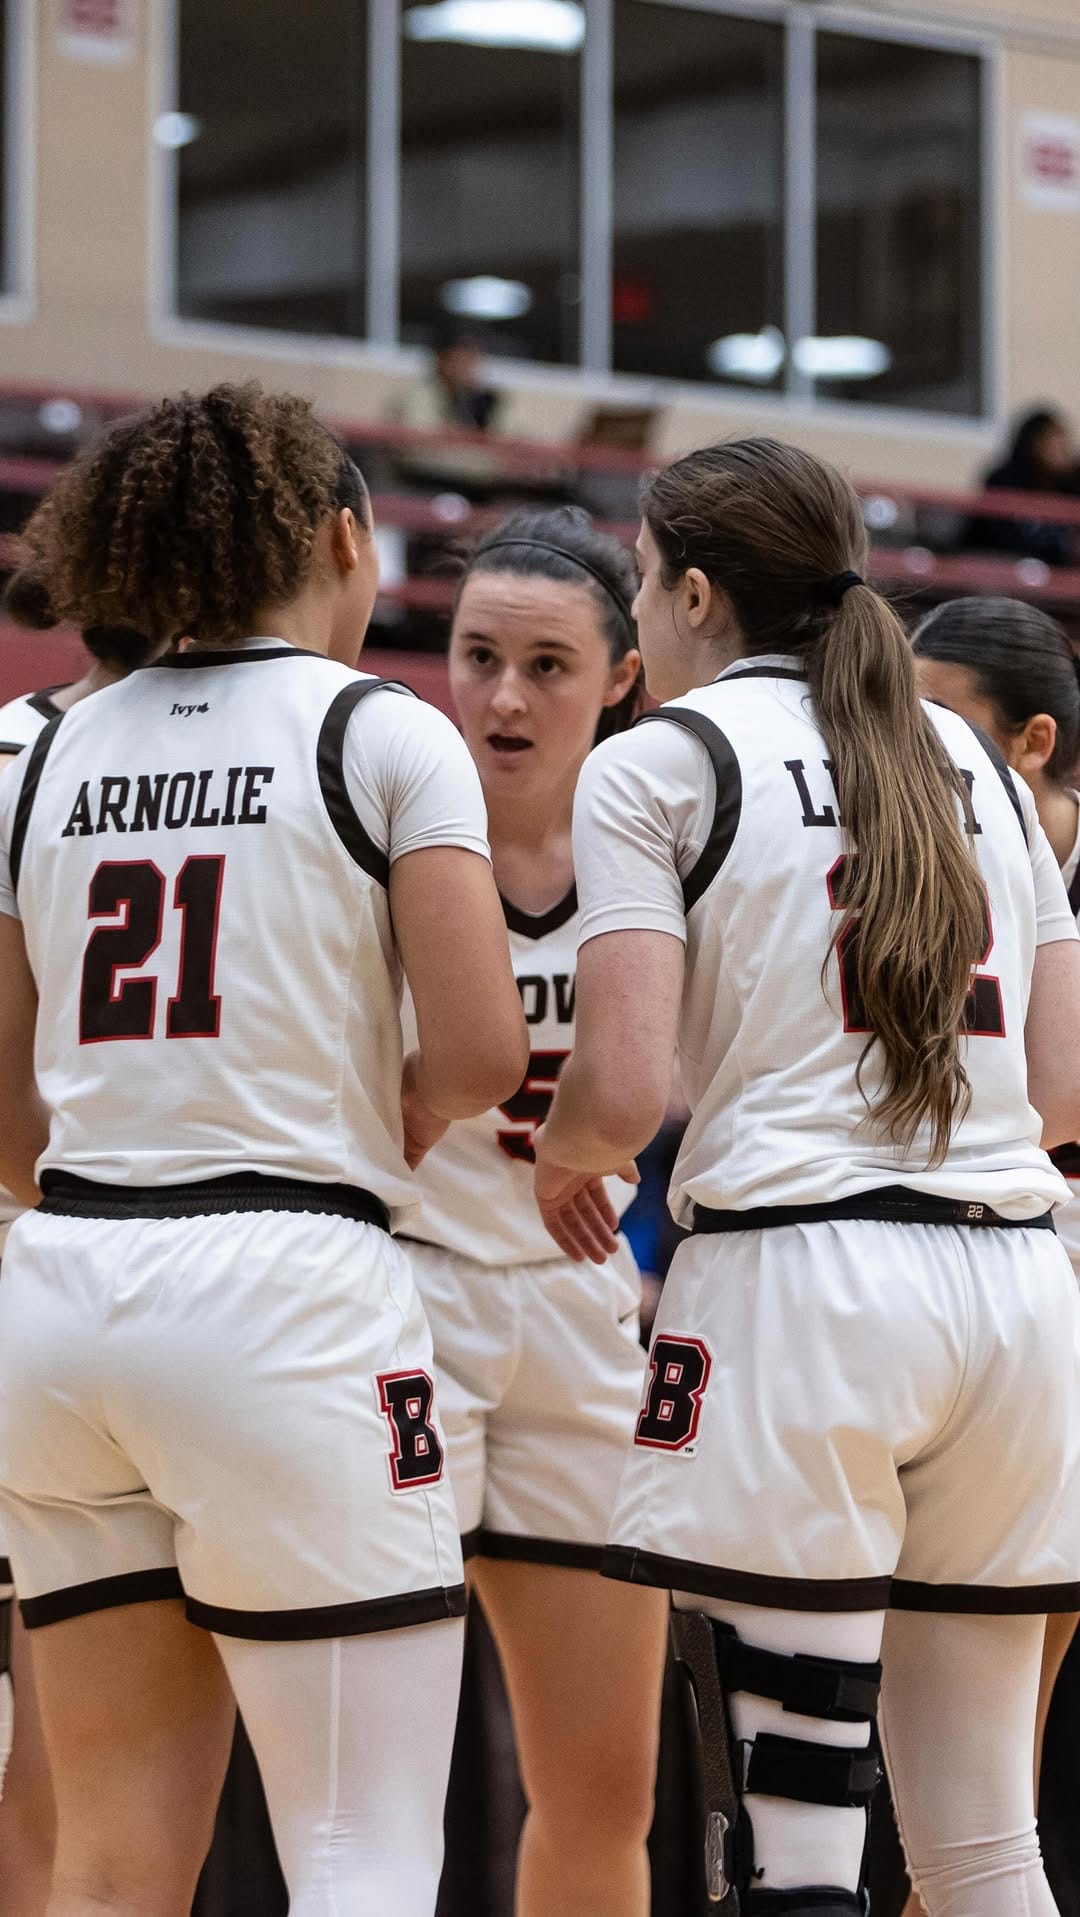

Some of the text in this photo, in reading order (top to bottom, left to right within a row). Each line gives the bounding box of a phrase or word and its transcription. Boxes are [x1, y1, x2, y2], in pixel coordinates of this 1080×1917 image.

[169, 703, 198, 718] Ivy
[61, 766, 275, 837] ARNOLIE
[79, 854, 226, 1045] 21
[967, 1204, 984, 1218] 22
[376, 1368, 444, 1490] B
[634, 1333, 712, 1451] B
